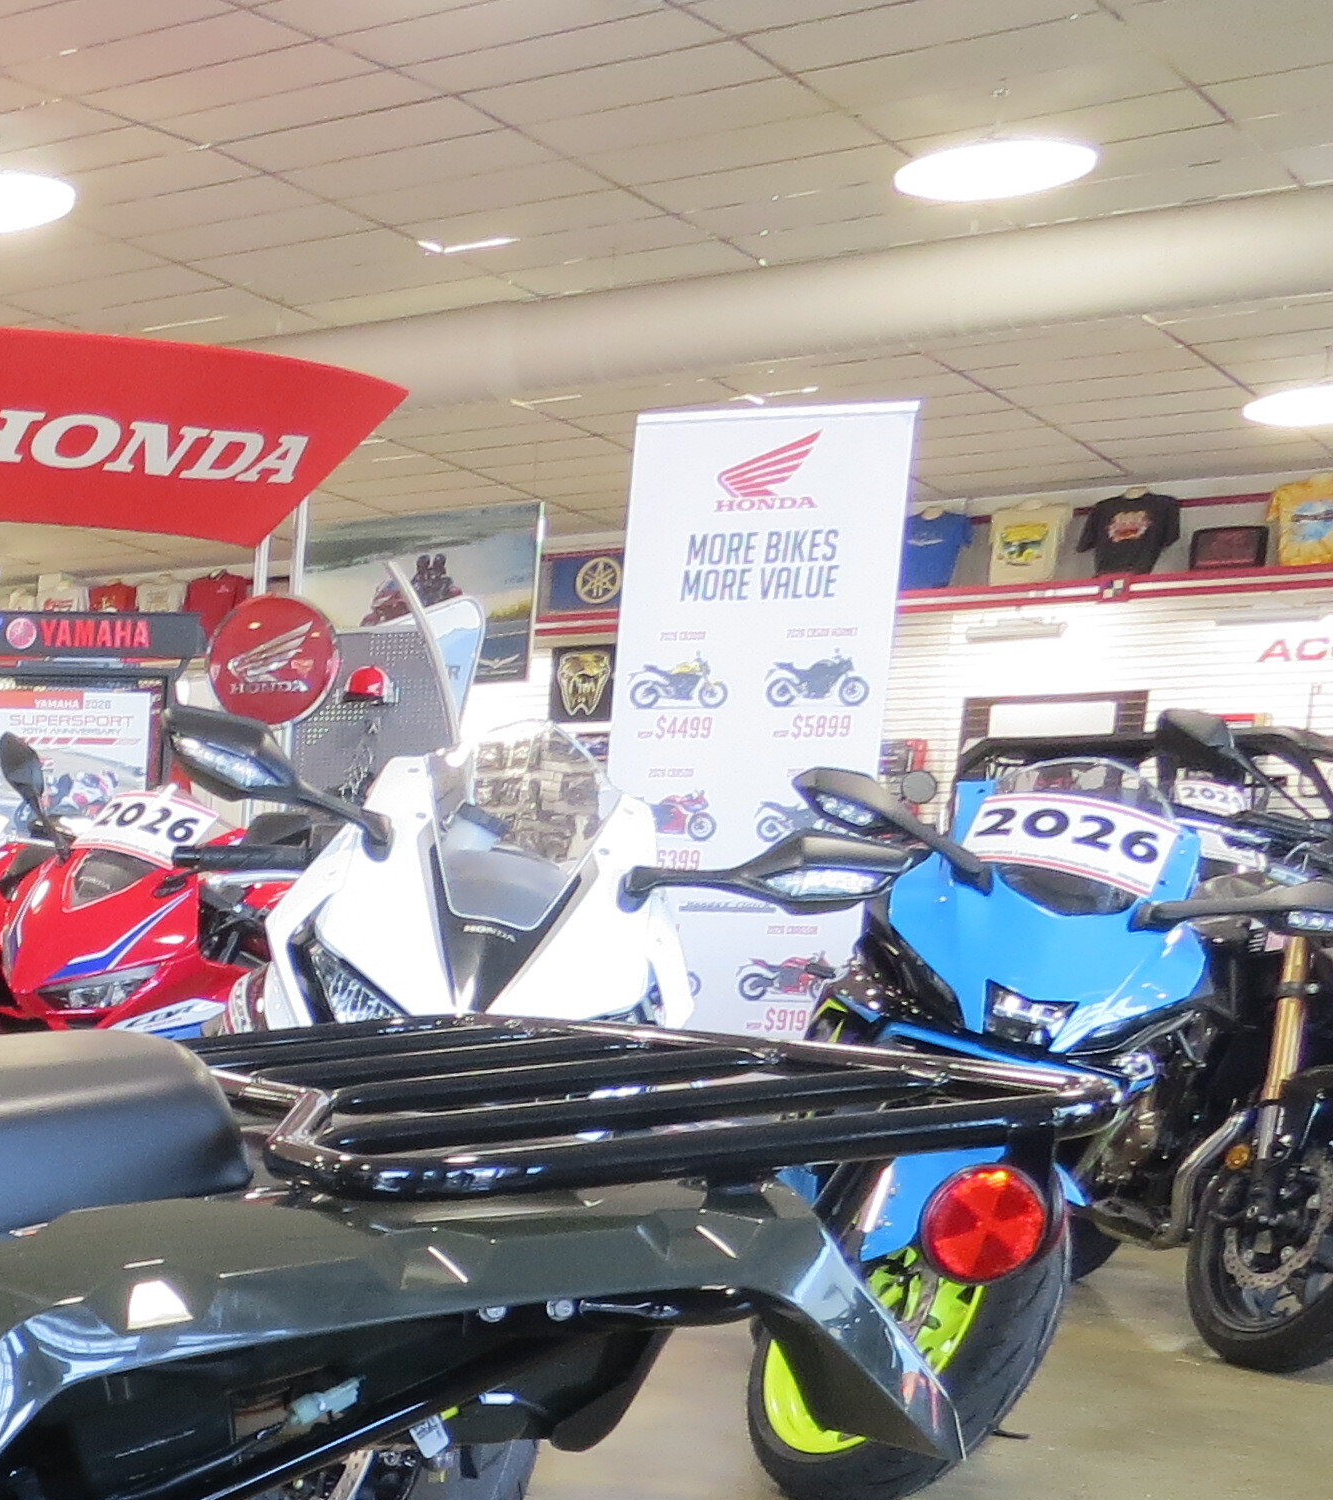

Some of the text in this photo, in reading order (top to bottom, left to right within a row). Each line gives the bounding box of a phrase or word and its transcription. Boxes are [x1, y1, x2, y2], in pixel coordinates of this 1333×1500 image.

[714, 496, 818, 513] HONDA
[686, 529, 840, 566] MORE BIKES
[680, 565, 841, 602] MORE VALUE
[40, 619, 150, 648] YAMAHA
[1256, 637, 1333, 662] AC
[229, 680, 310, 695] HONDA
[34, 698, 80, 710] YAMAHA
[9, 714, 134, 728] SUPERSPORT
[49, 728, 122, 736] ANNIVERSARY
[654, 714, 713, 740] $4499
[790, 713, 852, 740] $5899
[94, 800, 200, 843] 2026
[975, 807, 1160, 864] 2026
[463, 924, 516, 942] HONDA
[764, 1007, 807, 1031] $919
